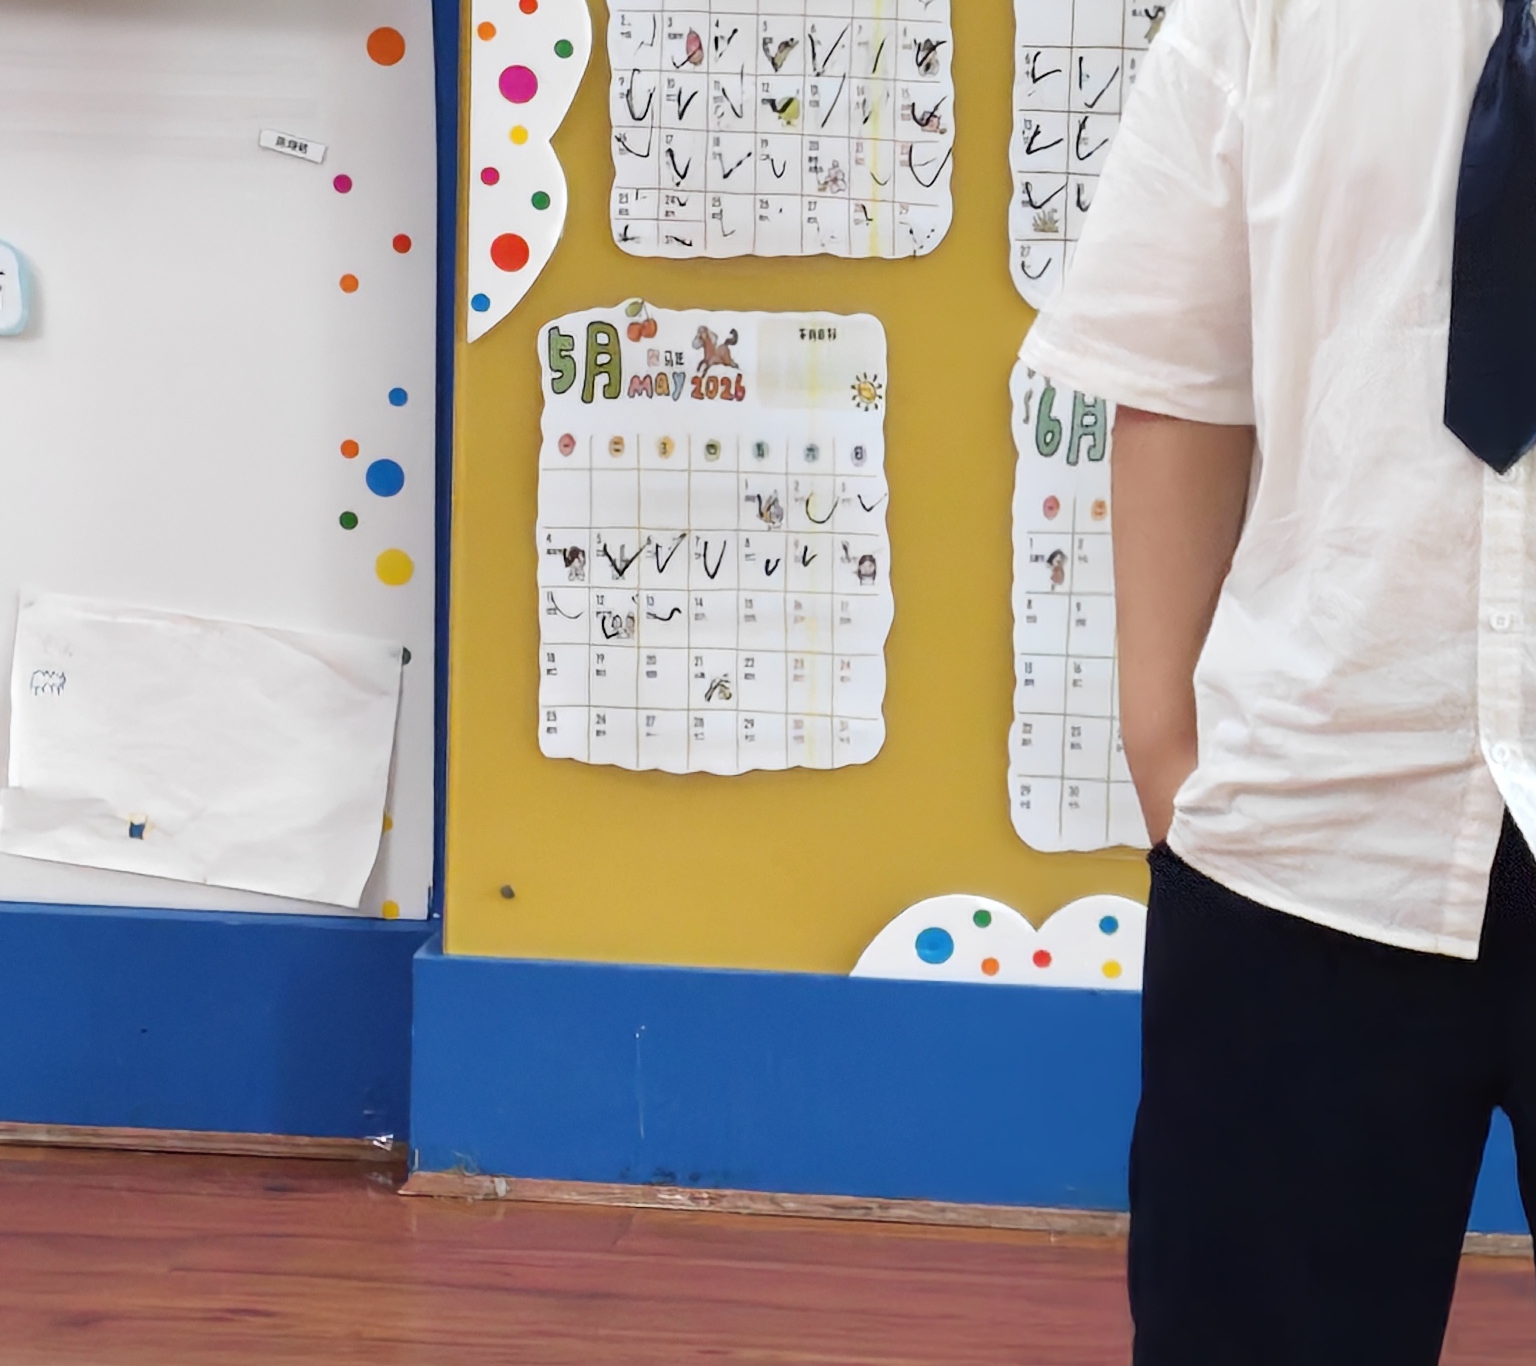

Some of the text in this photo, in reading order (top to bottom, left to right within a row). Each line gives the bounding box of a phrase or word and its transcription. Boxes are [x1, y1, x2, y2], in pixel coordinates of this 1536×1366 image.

[548, 321, 622, 404] 5月
[690, 373, 746, 402] 2026
[1034, 385, 1108, 466] 6月
